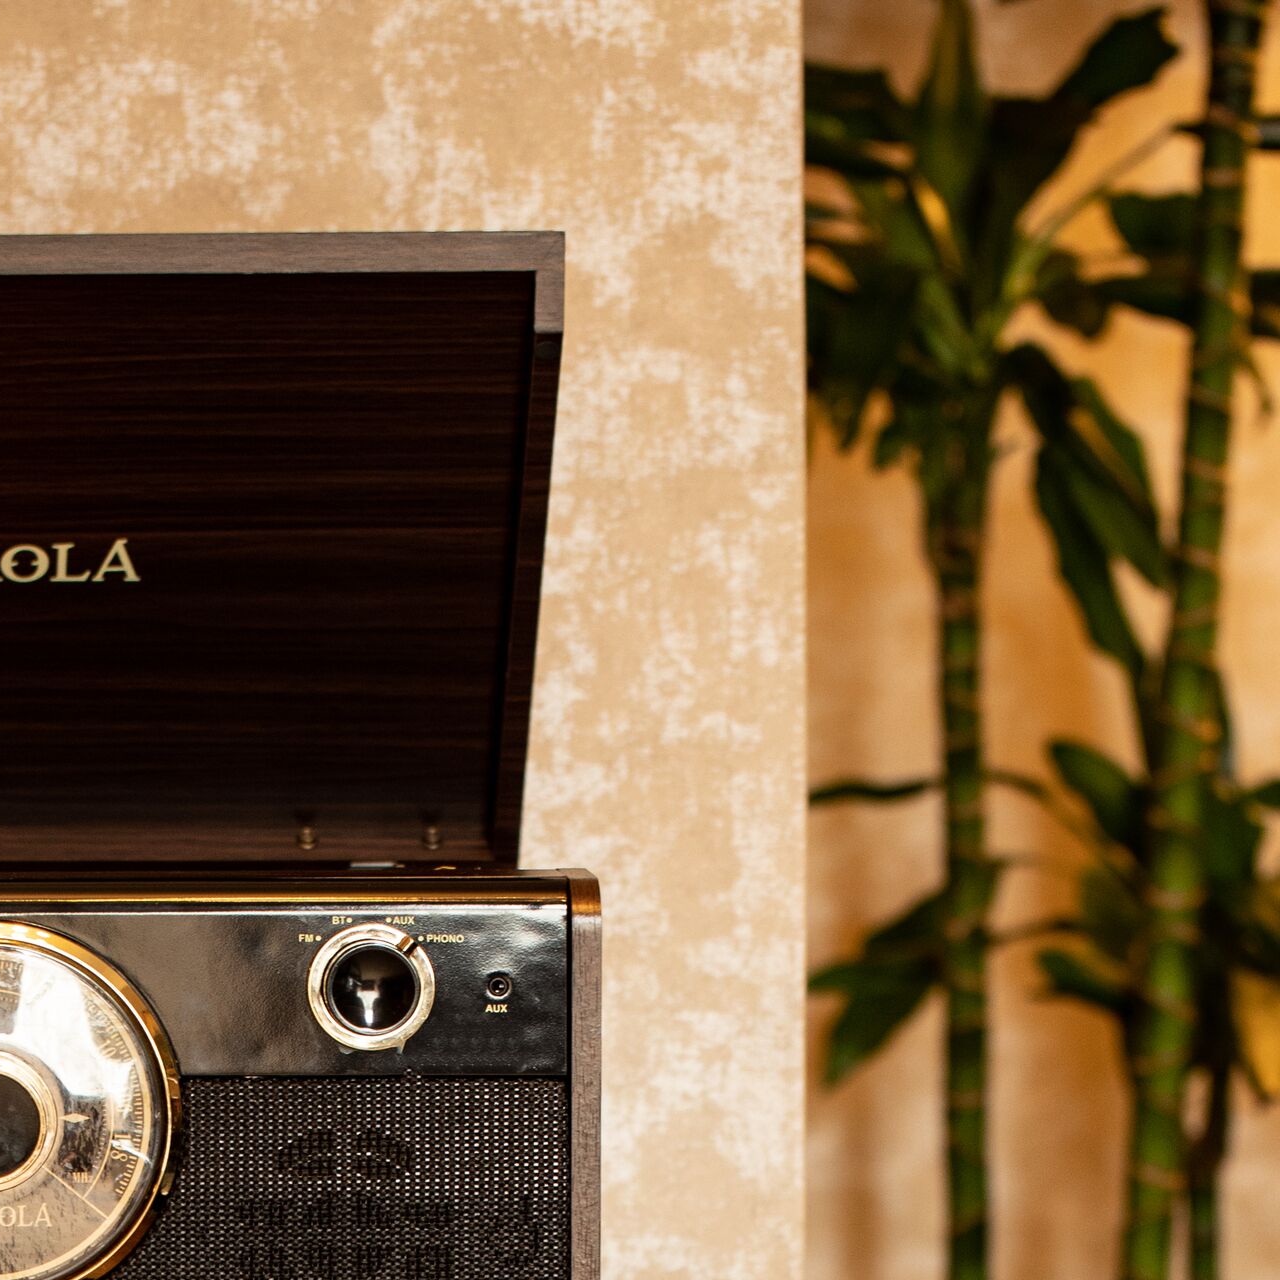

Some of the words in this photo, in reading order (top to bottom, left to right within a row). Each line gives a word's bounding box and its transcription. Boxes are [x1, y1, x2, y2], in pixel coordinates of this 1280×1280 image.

[332, 916, 347, 925] BT
[392, 916, 415, 925] AUX
[298, 934, 314, 943] FM
[426, 934, 465, 943] PHONO
[485, 1004, 508, 1013] AUX
